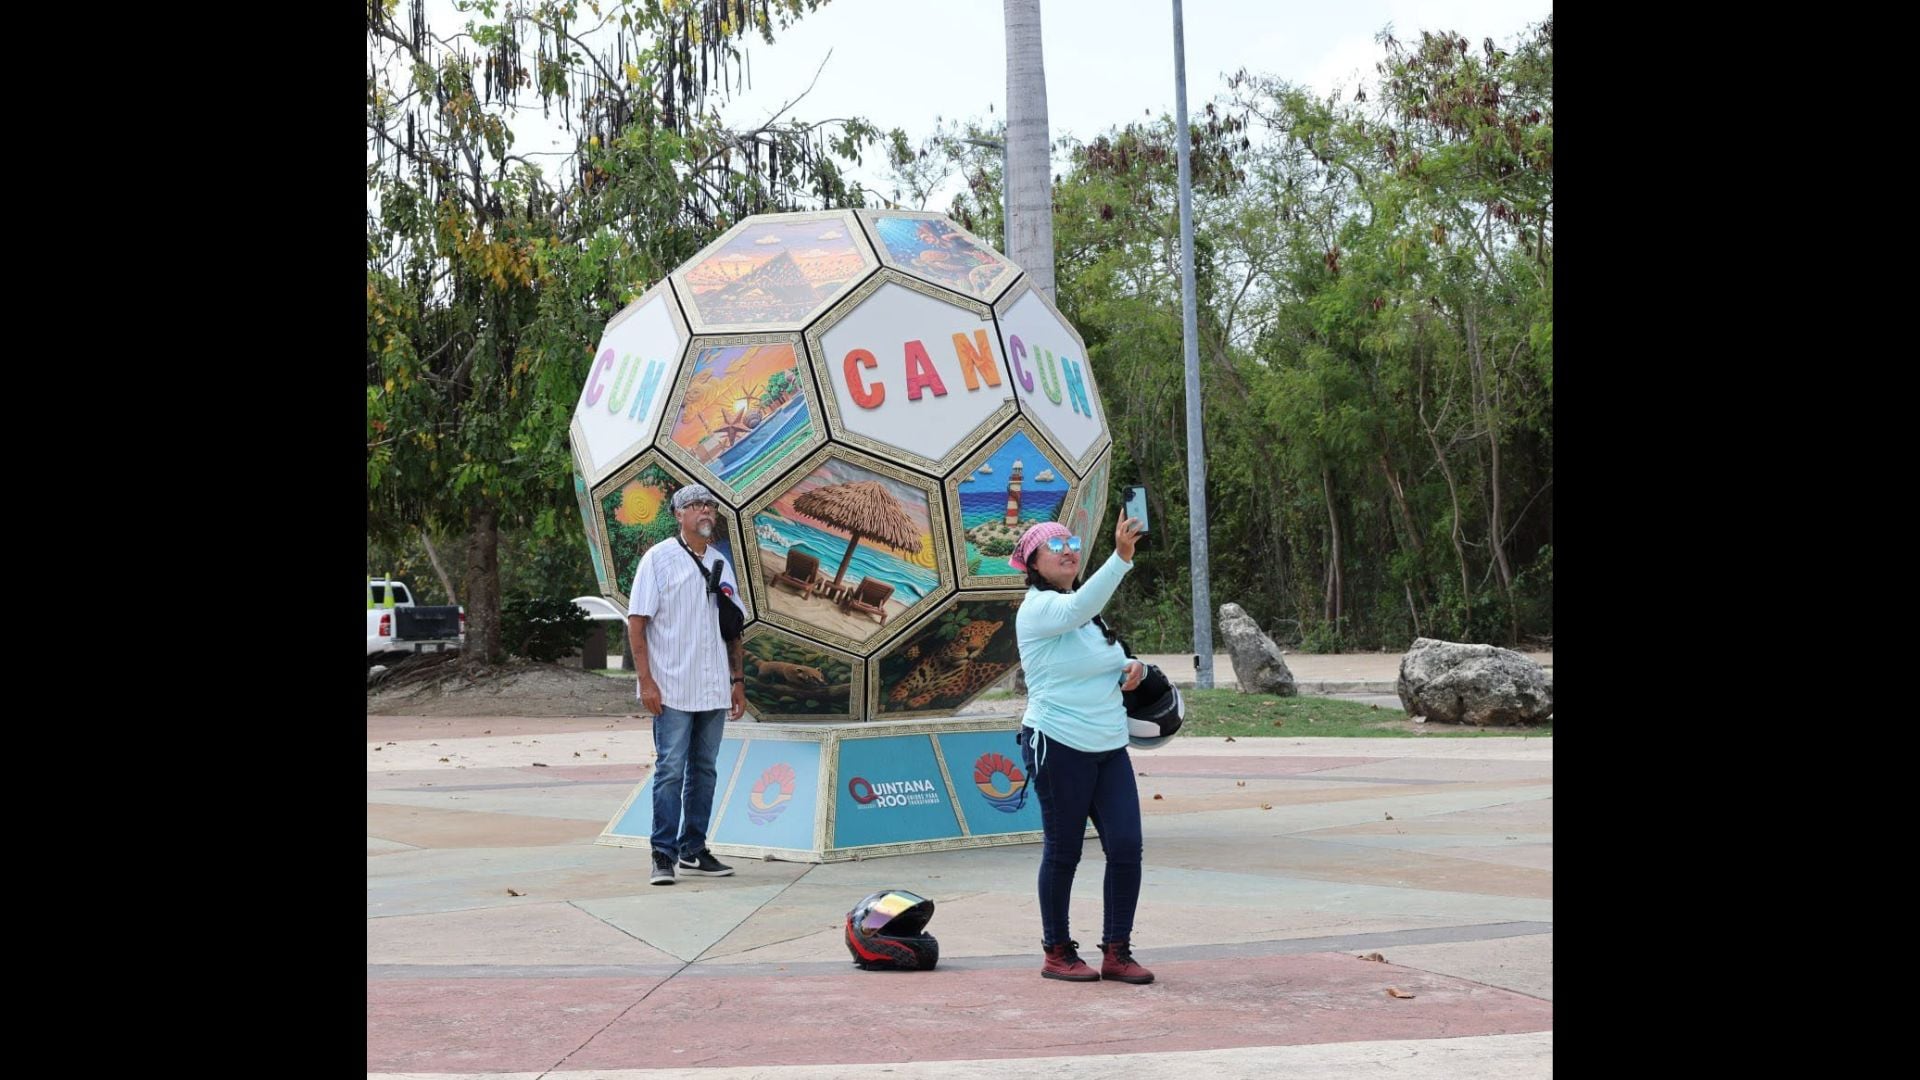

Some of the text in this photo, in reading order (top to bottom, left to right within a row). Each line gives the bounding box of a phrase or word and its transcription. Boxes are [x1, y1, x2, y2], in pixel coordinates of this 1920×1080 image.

[585, 348, 666, 422] CUN
[848, 776, 935, 804] QUINTANA
[876, 794, 907, 808] ROO
